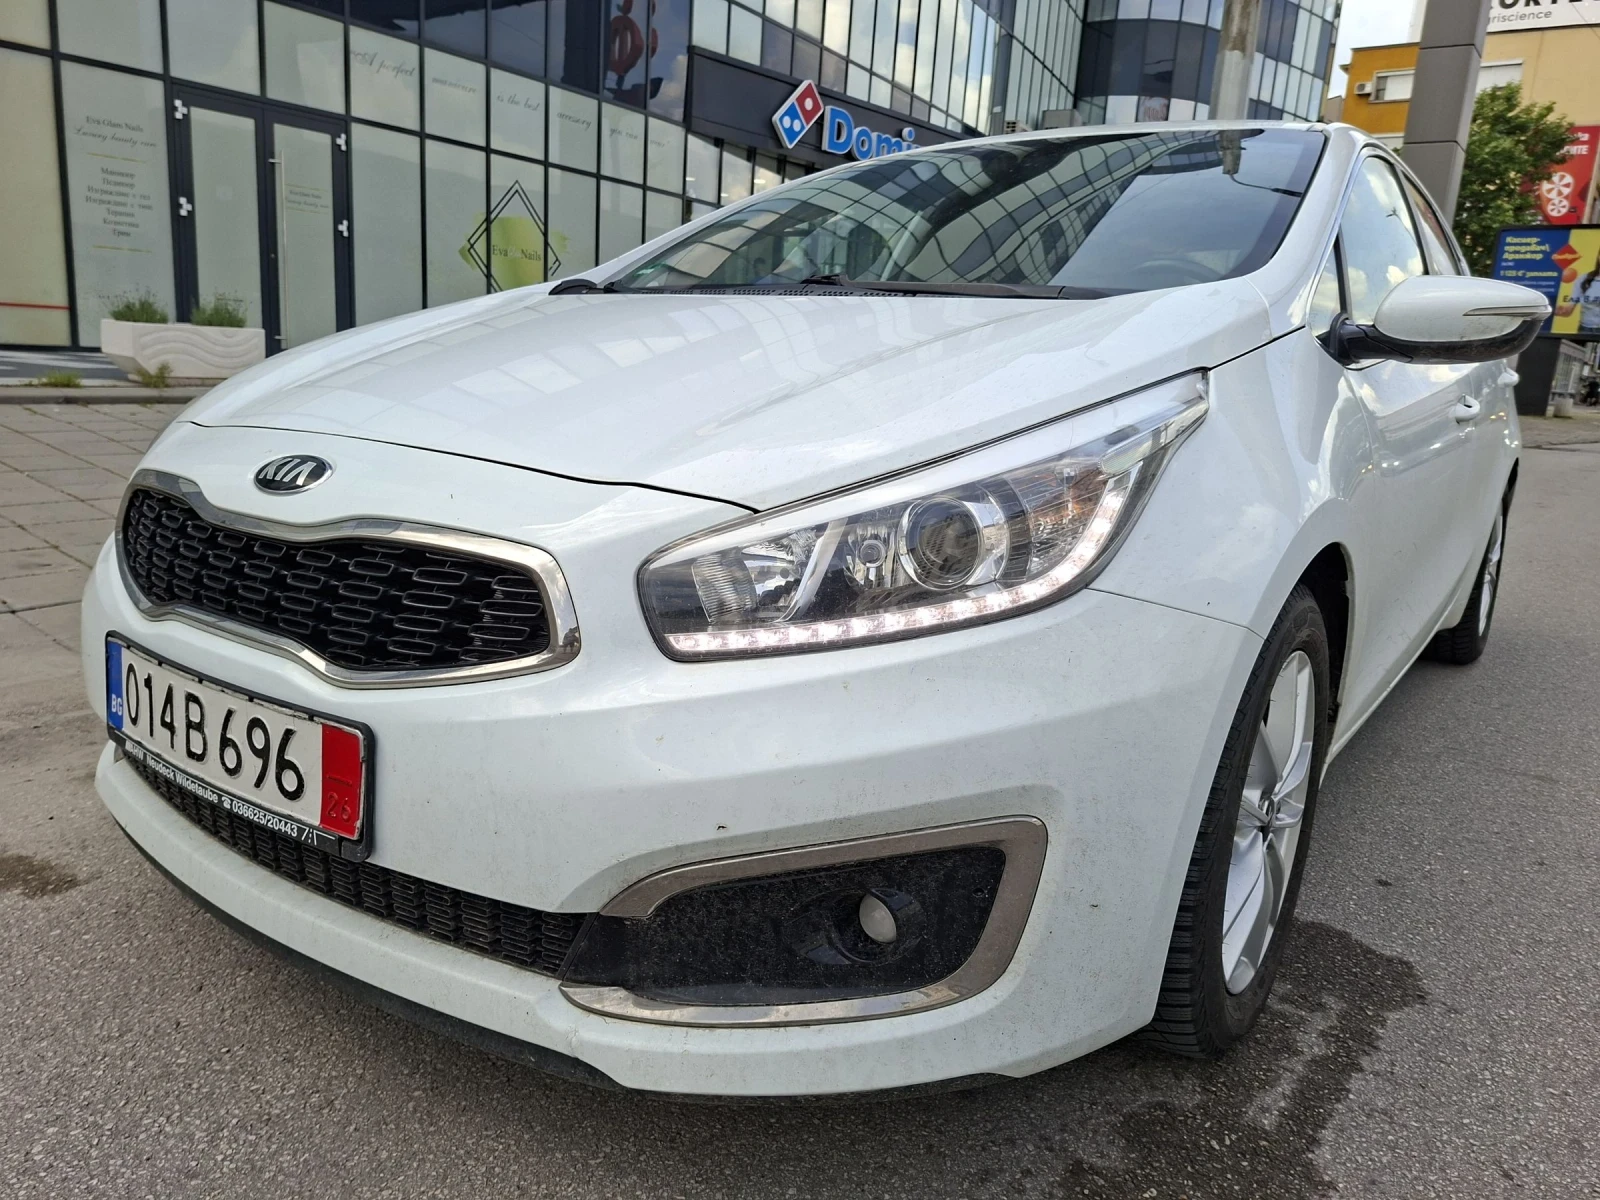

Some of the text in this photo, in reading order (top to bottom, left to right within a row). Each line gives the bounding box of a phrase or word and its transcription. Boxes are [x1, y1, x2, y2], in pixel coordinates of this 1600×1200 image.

[86, 115, 144, 133] Eva Glam Nails
[507, 93, 521, 106] the
[524, 97, 541, 112] best
[556, 111, 592, 132] accessory
[109, 132, 138, 148] beauty
[822, 106, 922, 160] Domi
[492, 244, 508, 257] Eva
[520, 248, 542, 261] Nails
[258, 457, 317, 486] KIA
[111, 693, 123, 716] BG
[146, 754, 175, 781] Neudeck
[175, 770, 219, 804] Wildetaube
[232, 800, 298, 838] 036625/20443
